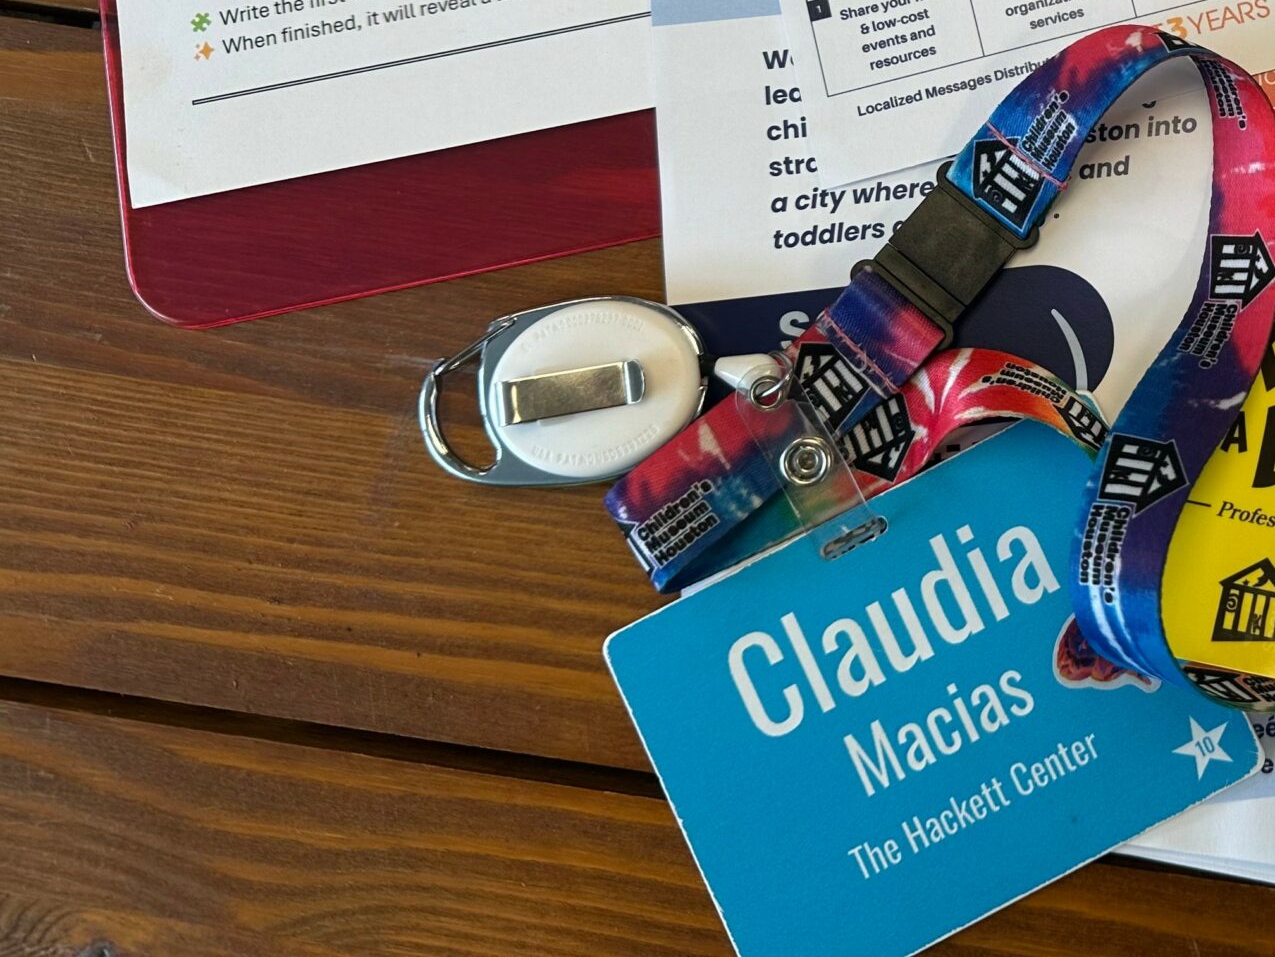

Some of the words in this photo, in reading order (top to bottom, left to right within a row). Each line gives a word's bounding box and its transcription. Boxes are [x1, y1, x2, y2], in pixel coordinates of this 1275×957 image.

[839, 3, 880, 21] Share
[859, 23, 871, 35] &
[871, 8, 930, 32] low-cost
[1029, 8, 1085, 30] services
[861, 34, 909, 54] events
[909, 24, 936, 42] and
[869, 46, 937, 71] resources
[856, 89, 924, 117] Localized
[924, 74, 993, 100] Messages
[1147, 116, 1198, 137] into
[1078, 155, 1130, 180] and
[770, 194, 789, 213] a
[795, 186, 846, 214] city
[852, 178, 937, 207] where
[773, 220, 886, 251] toddlers
[1221, 409, 1248, 453] A
[636, 479, 713, 542] Children's
[648, 500, 710, 554] Museum
[655, 515, 718, 567] Houston
[727, 523, 1061, 739] Claudia
[842, 669, 1036, 797] Macias
[1194, 735, 1214, 757] 10
[848, 831, 903, 880] The
[901, 779, 1011, 859] Hackett
[1012, 732, 1100, 799] Center
